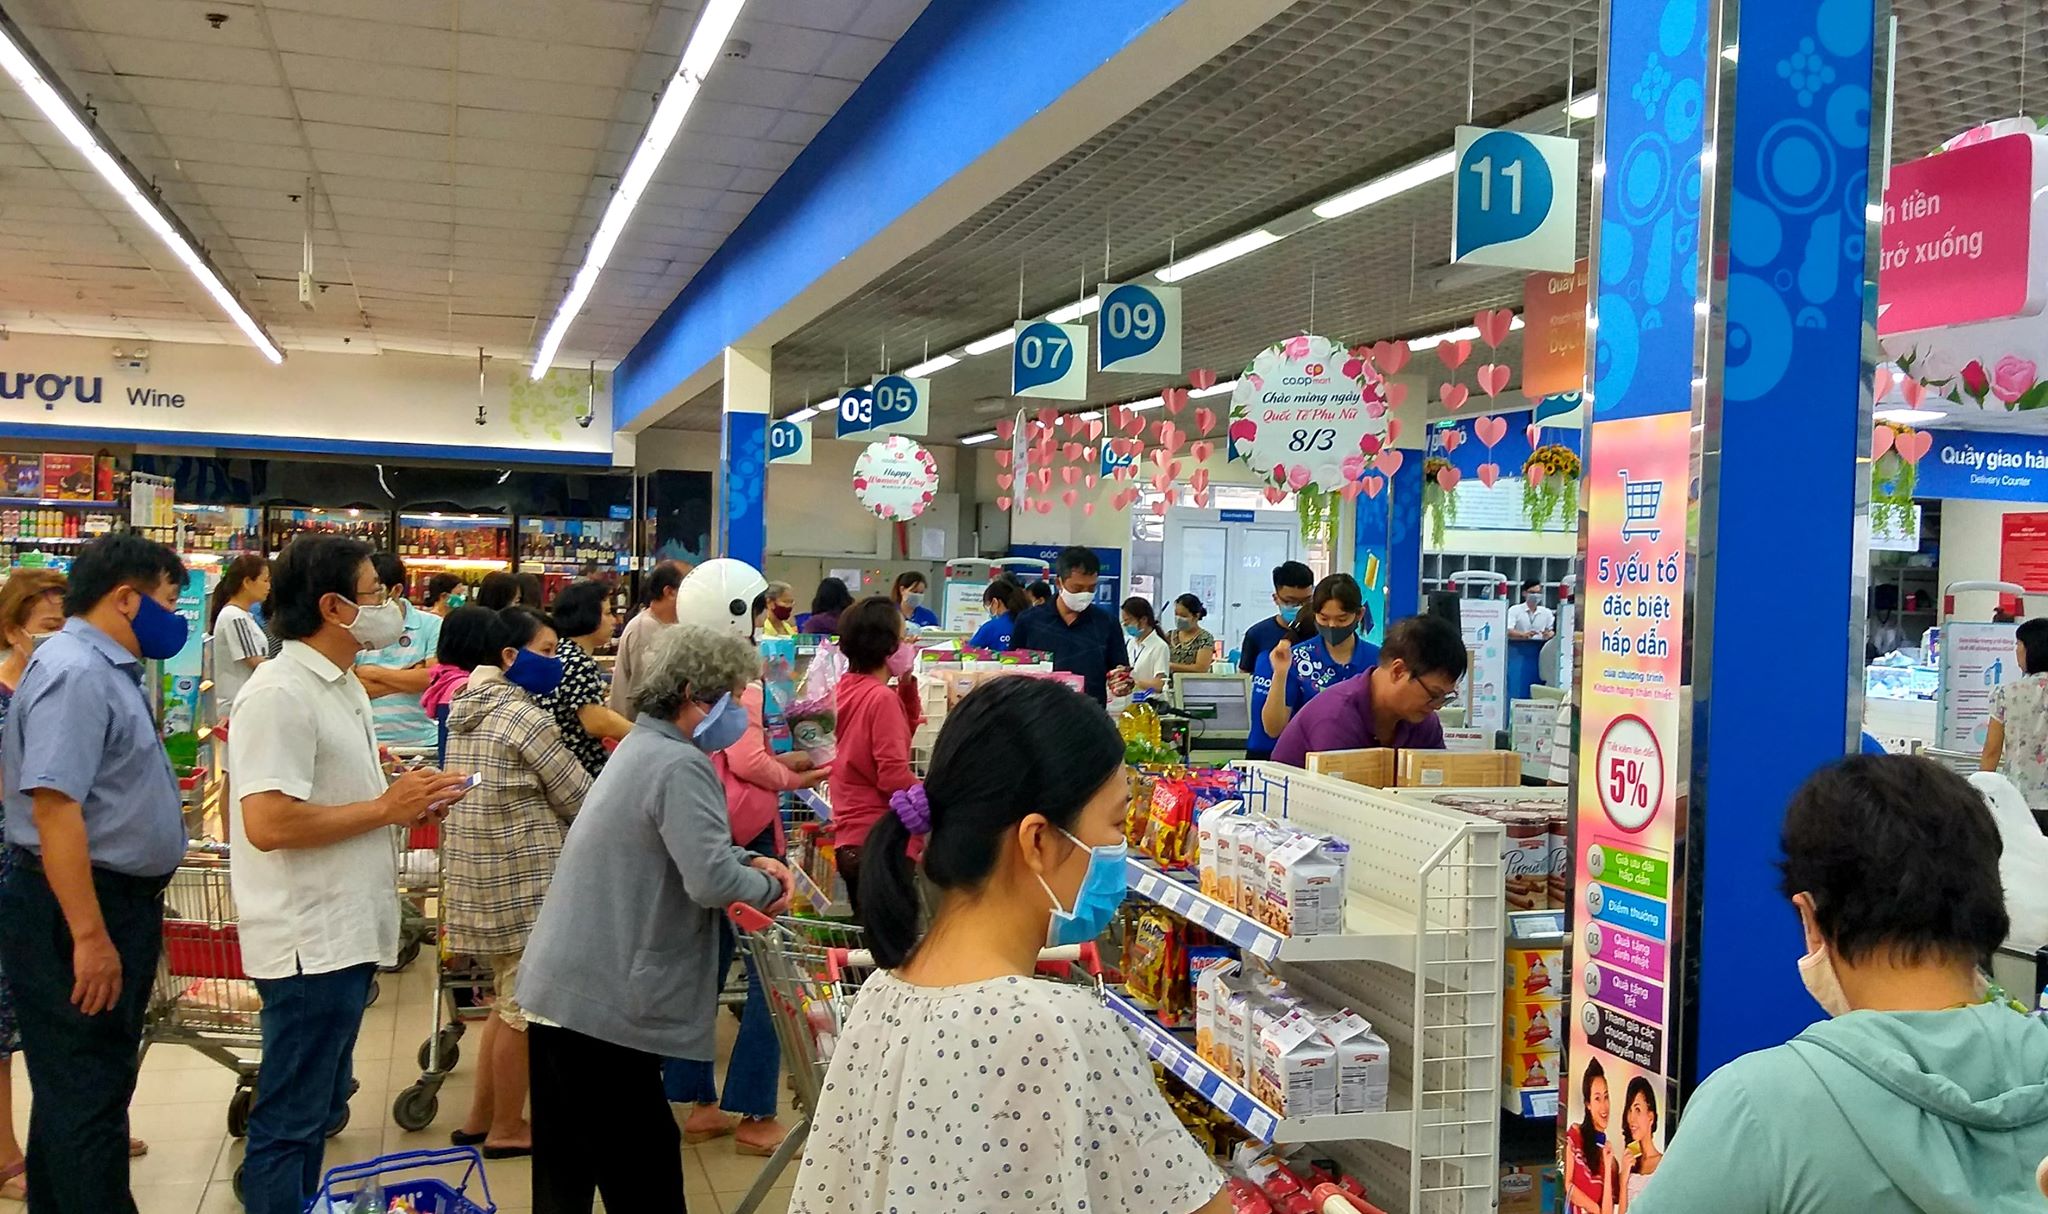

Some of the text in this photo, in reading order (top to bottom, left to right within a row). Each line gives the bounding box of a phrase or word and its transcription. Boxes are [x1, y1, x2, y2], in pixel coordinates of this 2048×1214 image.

[1470, 156, 1522, 215] 11
[1901, 189, 1940, 222] tiền
[1915, 225, 1983, 264] xuống
[1108, 302, 1157, 340] 09
[1021, 336, 1069, 369] 07
[127, 387, 185, 408] Wine
[841, 397, 872, 423] 03
[877, 386, 912, 412] 05
[1262, 390, 1361, 406] Chào mừng ngày
[1263, 408, 1359, 424] Quốc Tế Phụ Nữ
[771, 428, 795, 448] 01
[1288, 428, 1337, 452] 8/3
[1941, 444, 1985, 470] Quầy
[1987, 450, 2023, 471] giao
[883, 468, 912, 478] Happy
[909, 478, 926, 488] Day
[1970, 474, 2031, 487] Delivery Counter
[1599, 551, 1679, 587] 5 yếu tố
[1603, 594, 1670, 623] đặc biệt
[1602, 627, 1667, 656] hấp dẫn
[1618, 670, 1645, 682] chương
[1647, 673, 1664, 682] trình
[801, 728, 817, 740] 25
[1610, 757, 1648, 808] 5%
[1591, 853, 1600, 867] 01
[1589, 892, 1600, 906] 02
[1630, 906, 1659, 927] thưởng
[1588, 932, 1599, 946] 03
[1631, 940, 1650, 957] tặng
[1586, 972, 1597, 987] 04
[1630, 983, 1649, 1000] tặng
[1585, 1010, 1656, 1039] 05 Tham gia các
[1604, 1025, 1654, 1053] chương trình
[1606, 1039, 1635, 1060] khuyến
